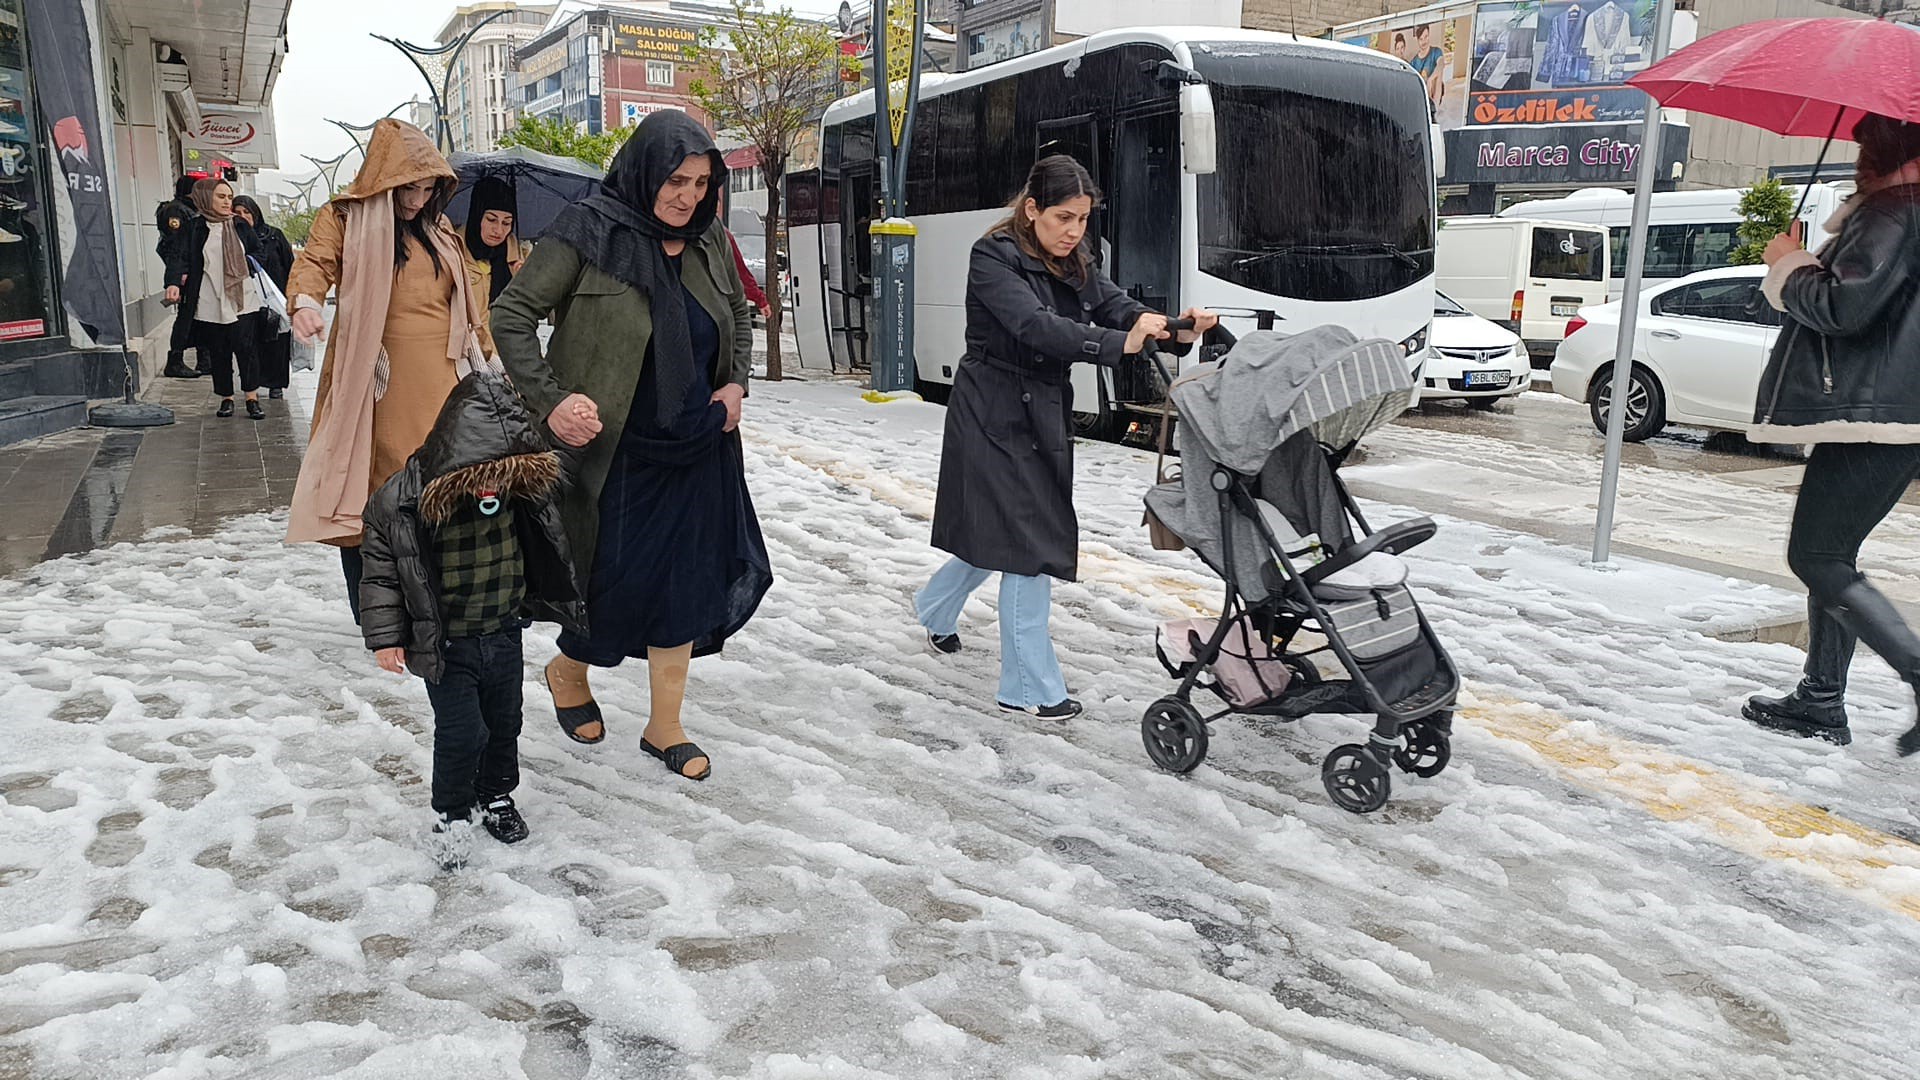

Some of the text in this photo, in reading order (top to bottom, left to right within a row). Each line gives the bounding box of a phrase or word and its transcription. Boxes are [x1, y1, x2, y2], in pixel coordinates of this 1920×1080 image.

[619, 24, 695, 41] MASAL DÜĞÜN
[637, 40, 679, 52] SALONU
[1474, 94, 1598, 123] Özdilek
[199, 120, 241, 136] Güven
[1477, 137, 1641, 172] Marca City
[1471, 373, 1480, 382] 06
[1480, 373, 1490, 383] BL
